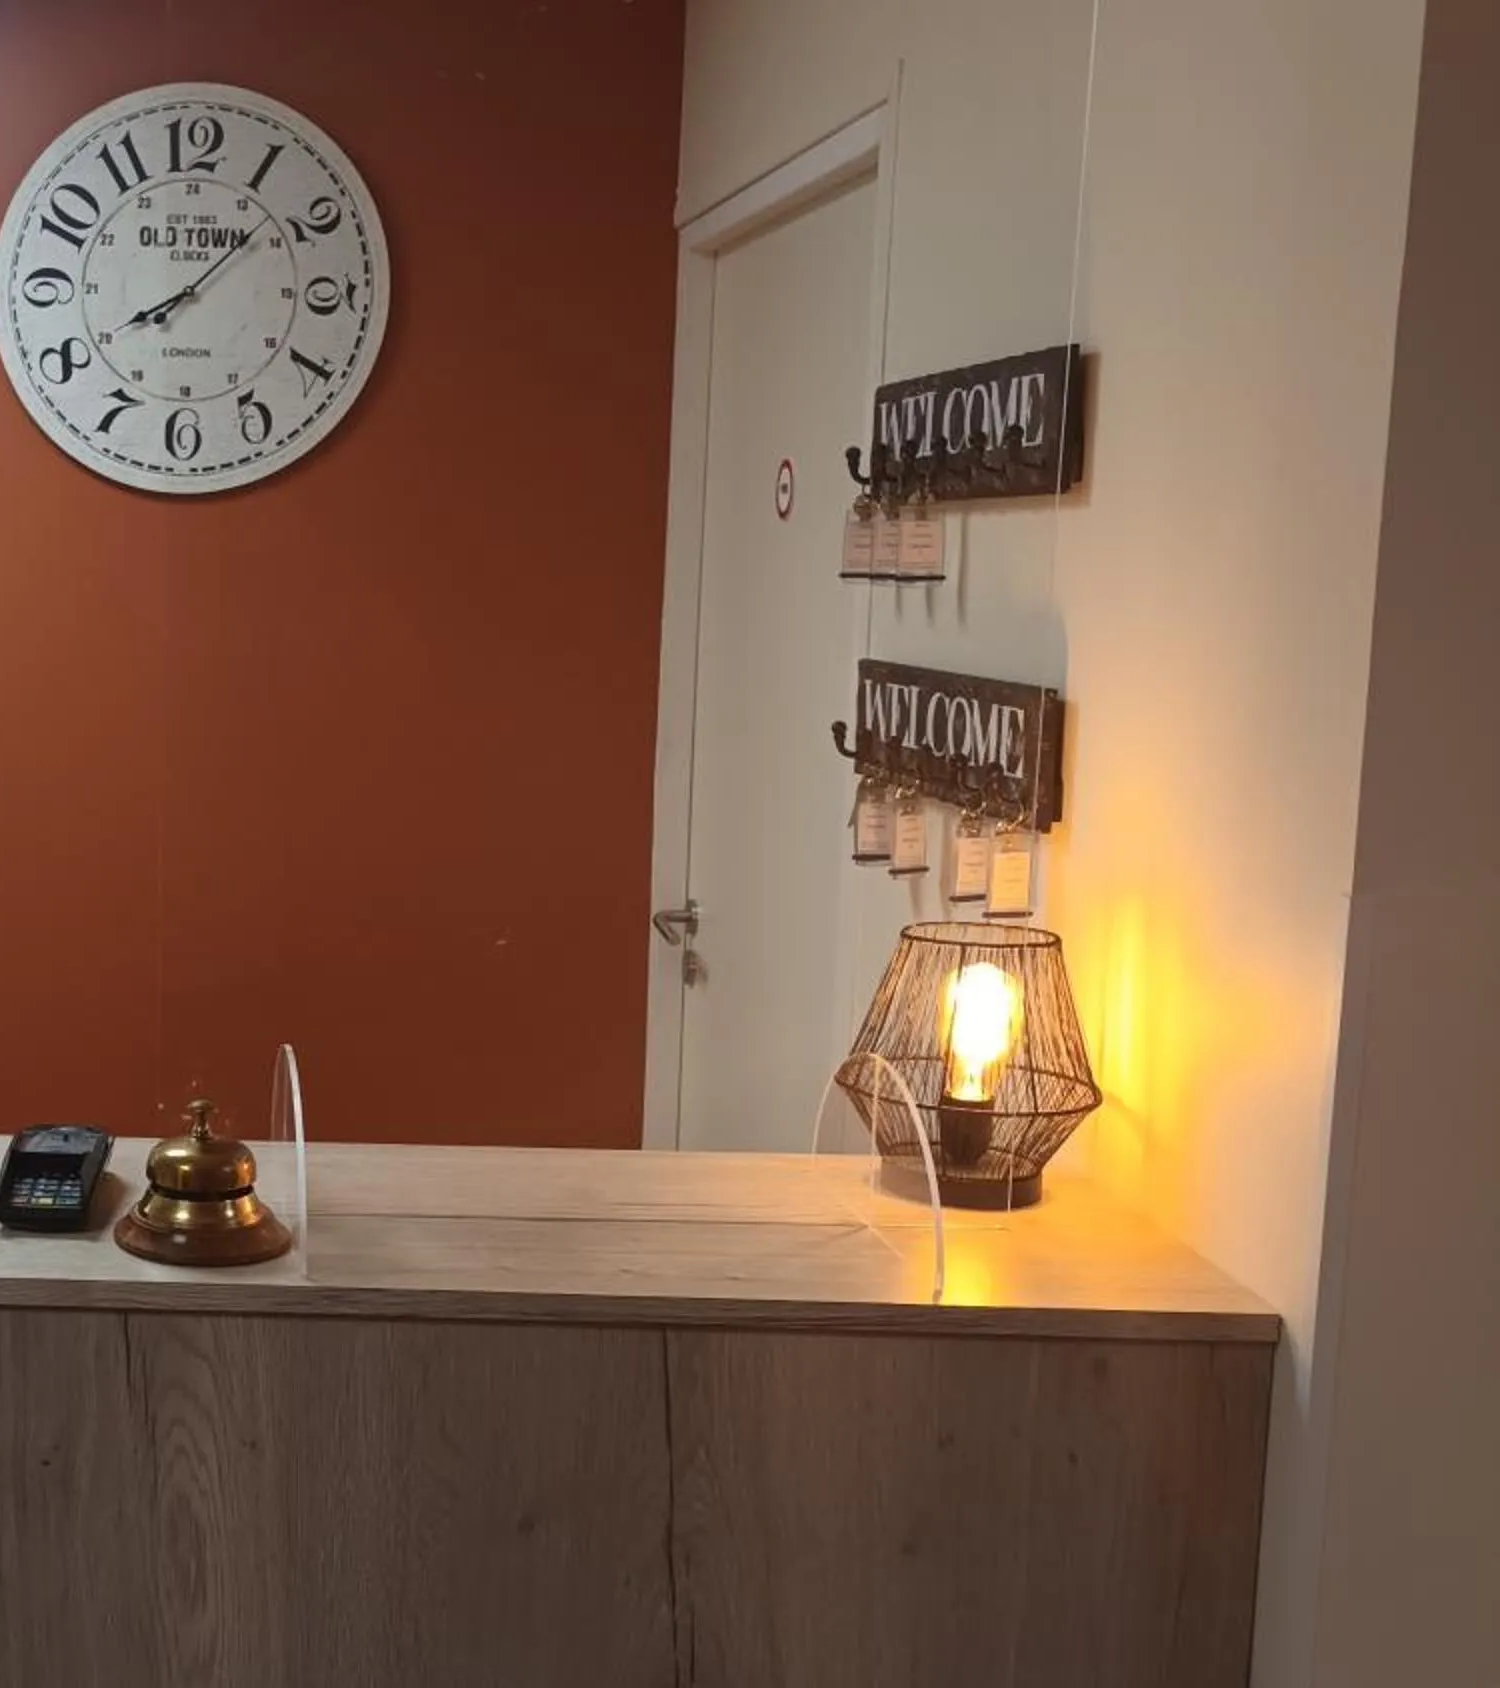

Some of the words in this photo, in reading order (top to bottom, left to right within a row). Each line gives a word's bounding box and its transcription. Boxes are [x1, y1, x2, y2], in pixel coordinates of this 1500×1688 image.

[164, 116, 227, 173] 12
[97, 130, 155, 196] 11
[243, 142, 285, 194] 1
[137, 197, 152, 209] 23
[185, 183, 200, 195] 24
[236, 199, 248, 211] 13
[40, 183, 101, 253] 10
[286, 196, 342, 244] 2
[99, 233, 115, 246] 22
[139, 226, 177, 247] OLD
[184, 227, 245, 249] TOWN
[269, 237, 282, 249] 14
[22, 267, 75, 309] 9
[85, 283, 98, 294] 21
[281, 287, 293, 300] 15
[304, 273, 358, 316] 3
[98, 333, 113, 345] 20
[162, 348, 212, 358] LONDON
[264, 337, 277, 349] 16
[39, 337, 92, 385] 8
[131, 370, 144, 382] 19
[289, 346, 335, 399] 4
[179, 385, 191, 397] 18
[227, 373, 239, 385] 17
[93, 388, 146, 434] 7
[237, 388, 273, 445] 5
[879, 372, 1045, 462] WELCOME
[164, 407, 202, 461] 6
[864, 678, 1025, 779] WELCOME
